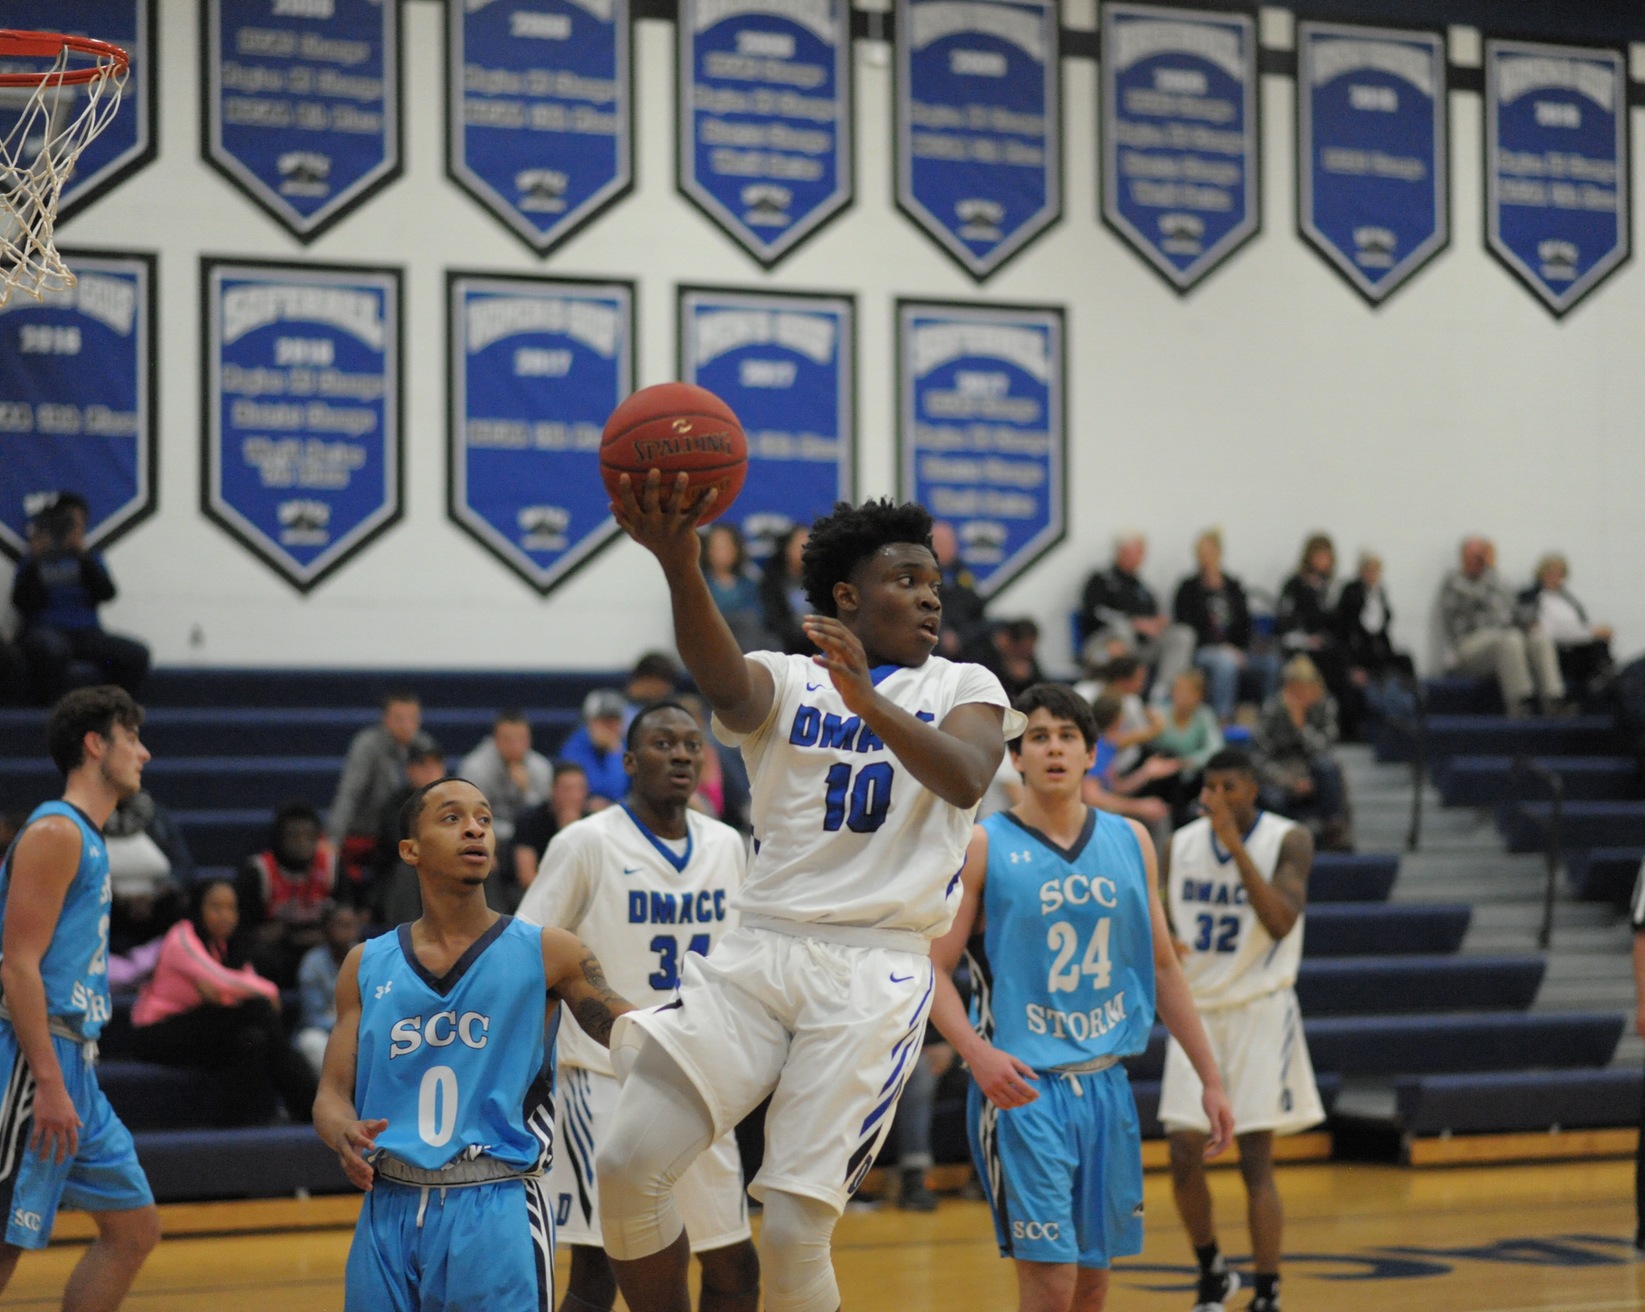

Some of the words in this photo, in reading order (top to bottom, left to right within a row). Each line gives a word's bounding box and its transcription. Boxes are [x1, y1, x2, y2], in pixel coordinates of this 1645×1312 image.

[632, 431, 733, 464] SPALDING
[789, 703, 935, 754] DMA
[823, 761, 895, 833] 10
[628, 888, 727, 924] DMACC
[1038, 874, 1118, 917] SCC
[1182, 879, 1246, 905] DMAC
[1047, 917, 1113, 993] 24
[1195, 914, 1241, 953] 32
[388, 1010, 491, 1060] SCC
[1025, 991, 1128, 1042] STORM
[418, 1065, 459, 1148] 0
[1013, 1220, 1060, 1241] SCC
